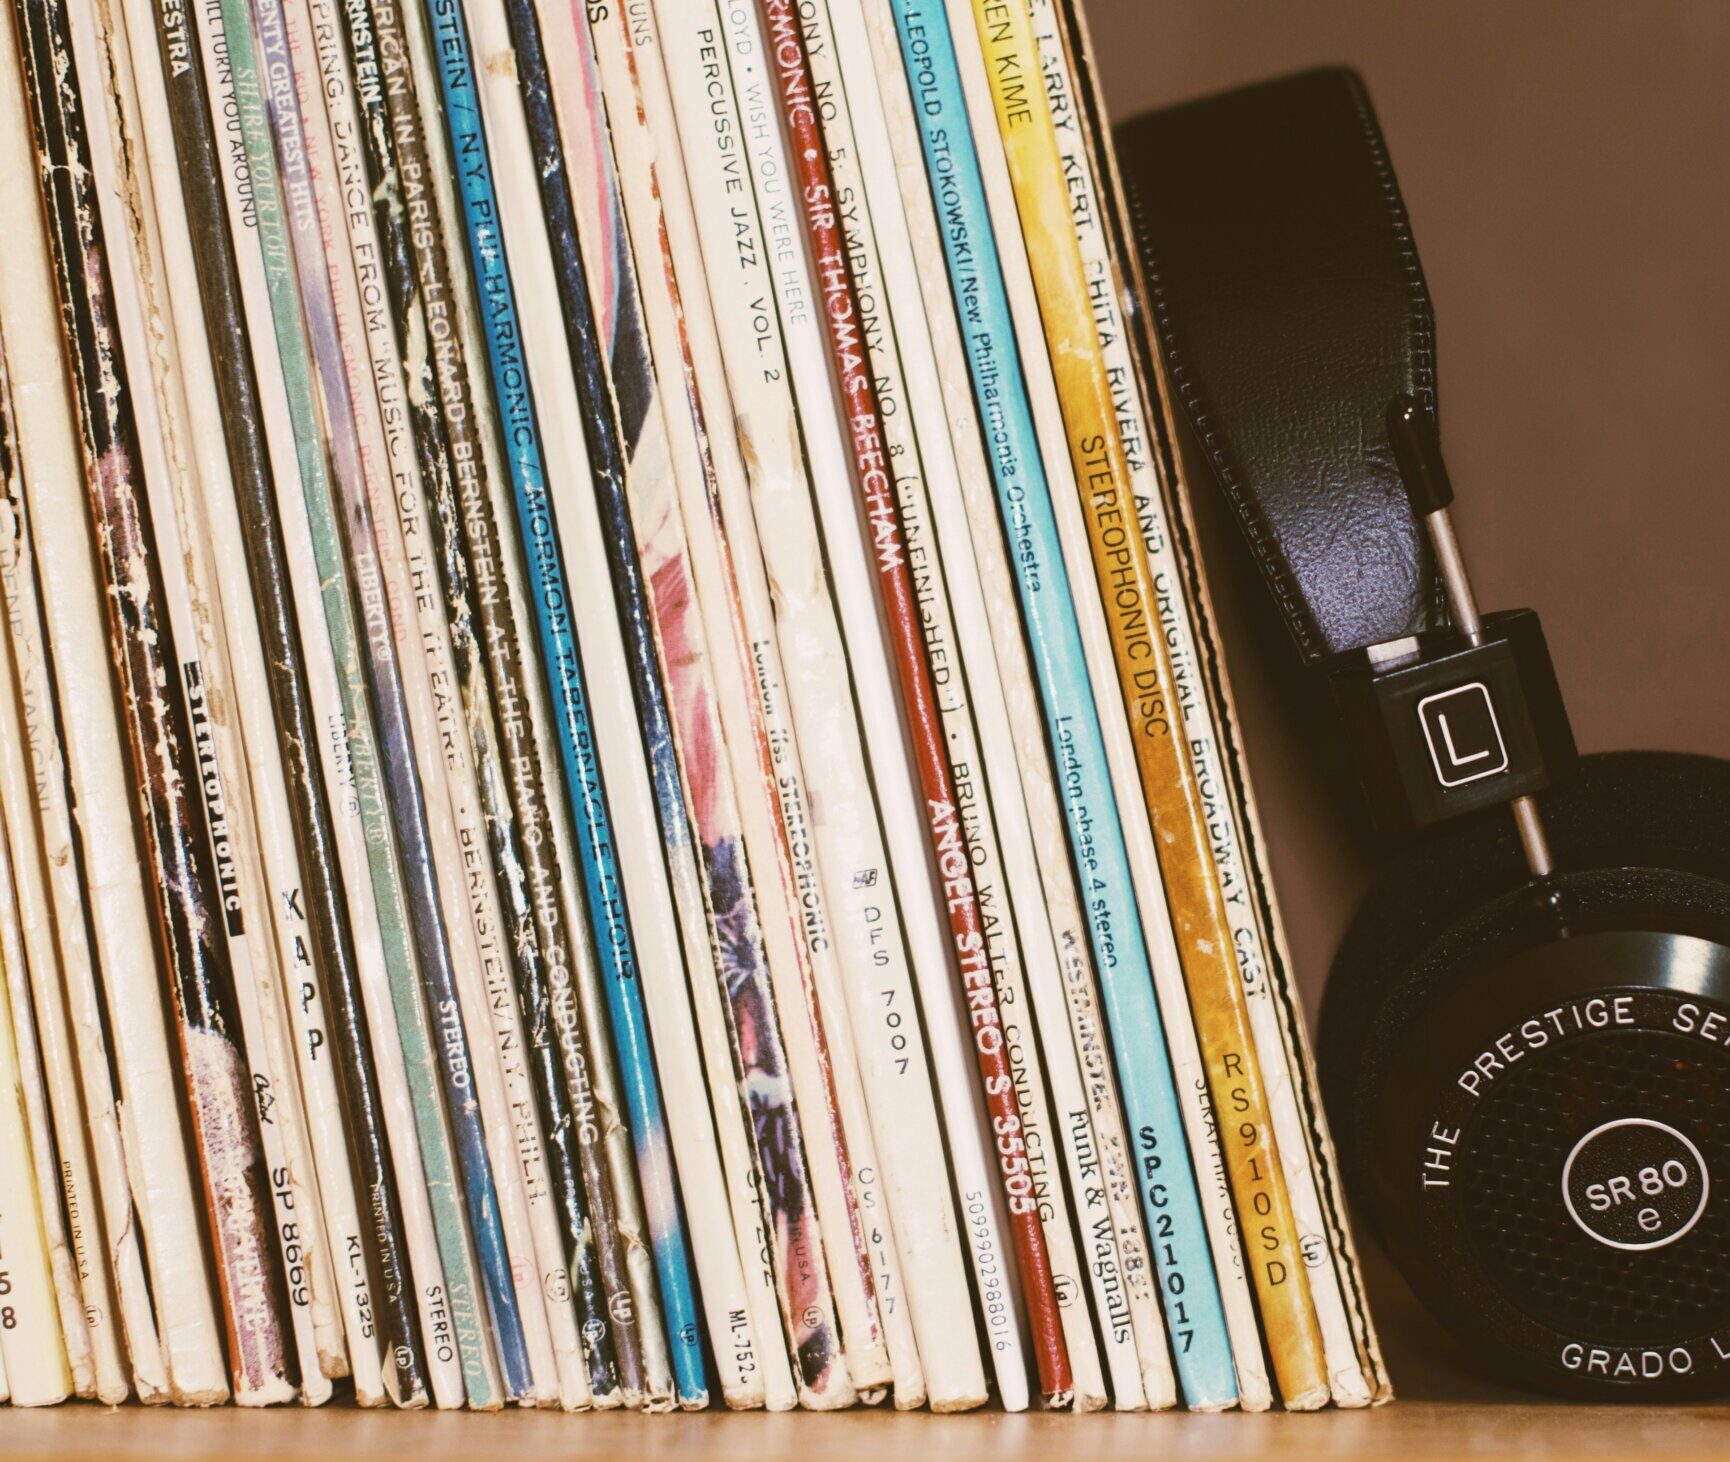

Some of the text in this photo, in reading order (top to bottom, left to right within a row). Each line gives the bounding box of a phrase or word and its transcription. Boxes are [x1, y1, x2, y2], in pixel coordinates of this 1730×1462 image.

[210, 34, 233, 84] TURN
[981, 0, 1033, 128] EN KIME
[220, 91, 240, 132] YOU
[268, 61, 306, 176] GREATEST
[290, 181, 316, 233] HITS
[390, 112, 416, 144] IN
[743, 83, 770, 140] WISH
[229, 140, 257, 229] AROUND
[333, 120, 369, 231] DANCE
[458, 132, 487, 188] N.Y.
[756, 146, 781, 194] YOU
[696, 29, 781, 384] PERCUSSIVE JAZZ VOL. 2
[767, 201, 794, 263] WERE
[803, 184, 837, 231] SIR
[354, 243, 388, 333] FROM
[470, 199, 533, 447] PHILHARMONIC
[780, 270, 807, 325] HERE
[816, 249, 870, 398] THOMAS
[903, 12, 943, 116] LEOPOLD
[970, 334, 1019, 478] Philharmonia
[1003, 486, 1044, 592] Orchestra
[395, 473, 422, 537] FOR
[450, 440, 500, 605] BERNSTEIN
[849, 413, 906, 573] BEECHAM
[1032, 33, 1073, 131] LARRY
[1104, 366, 1147, 472] RIVERA
[1132, 494, 1165, 553] AND
[1150, 572, 1202, 721] ORIGINAL
[1188, 738, 1243, 905] BROADWAY
[1231, 927, 1265, 999] CAST
[408, 551, 436, 613] THE
[524, 489, 567, 635] MORMON
[1078, 434, 1171, 738] STEREOPHONIC DISC
[485, 626, 510, 660] AT
[813, 82, 841, 131] NO.
[834, 187, 885, 353] SYMPHONY
[873, 376, 900, 426] NO.
[887, 444, 905, 458] 8
[951, 762, 989, 867] BRUNO
[974, 885, 1016, 1006] WALTER
[1002, 1024, 1058, 1223] CONDUCTING
[495, 676, 525, 740] THE
[1438, 713, 1490, 766] L
[189, 683, 241, 912] STEREOPHONIC
[554, 648, 611, 862] TABERNACLE
[1052, 716, 1088, 798] London
[509, 756, 545, 848] PIANO
[1068, 806, 1102, 870] phase
[530, 866, 560, 927] AND
[778, 775, 829, 955] STEREOPHONIC
[597, 875, 635, 981] CHOIR
[1091, 898, 1123, 967] stereo
[438, 1001, 472, 1089] STEREO
[543, 943, 601, 1147] CONDUCTING
[880, 991, 912, 1076] 7007
[927, 799, 1038, 1215] ANGEL STEREO S 35505
[1422, 1120, 1461, 1191] THE
[1457, 996, 1635, 1097] PRESTIGE
[1069, 1110, 1104, 1189] Funk
[271, 1166, 310, 1307] SP 8669
[1084, 1187, 1107, 1206] &
[1637, 1207, 1662, 1232] e
[347, 1236, 376, 1339] KL-1325
[964, 1191, 1012, 1351] 5099902988016
[1082, 1217, 1135, 1344] Wagnalls
[425, 1285, 455, 1363] STEREO
[448, 1280, 484, 1377] STEREO
[1561, 1343, 1693, 1379] GRADO
